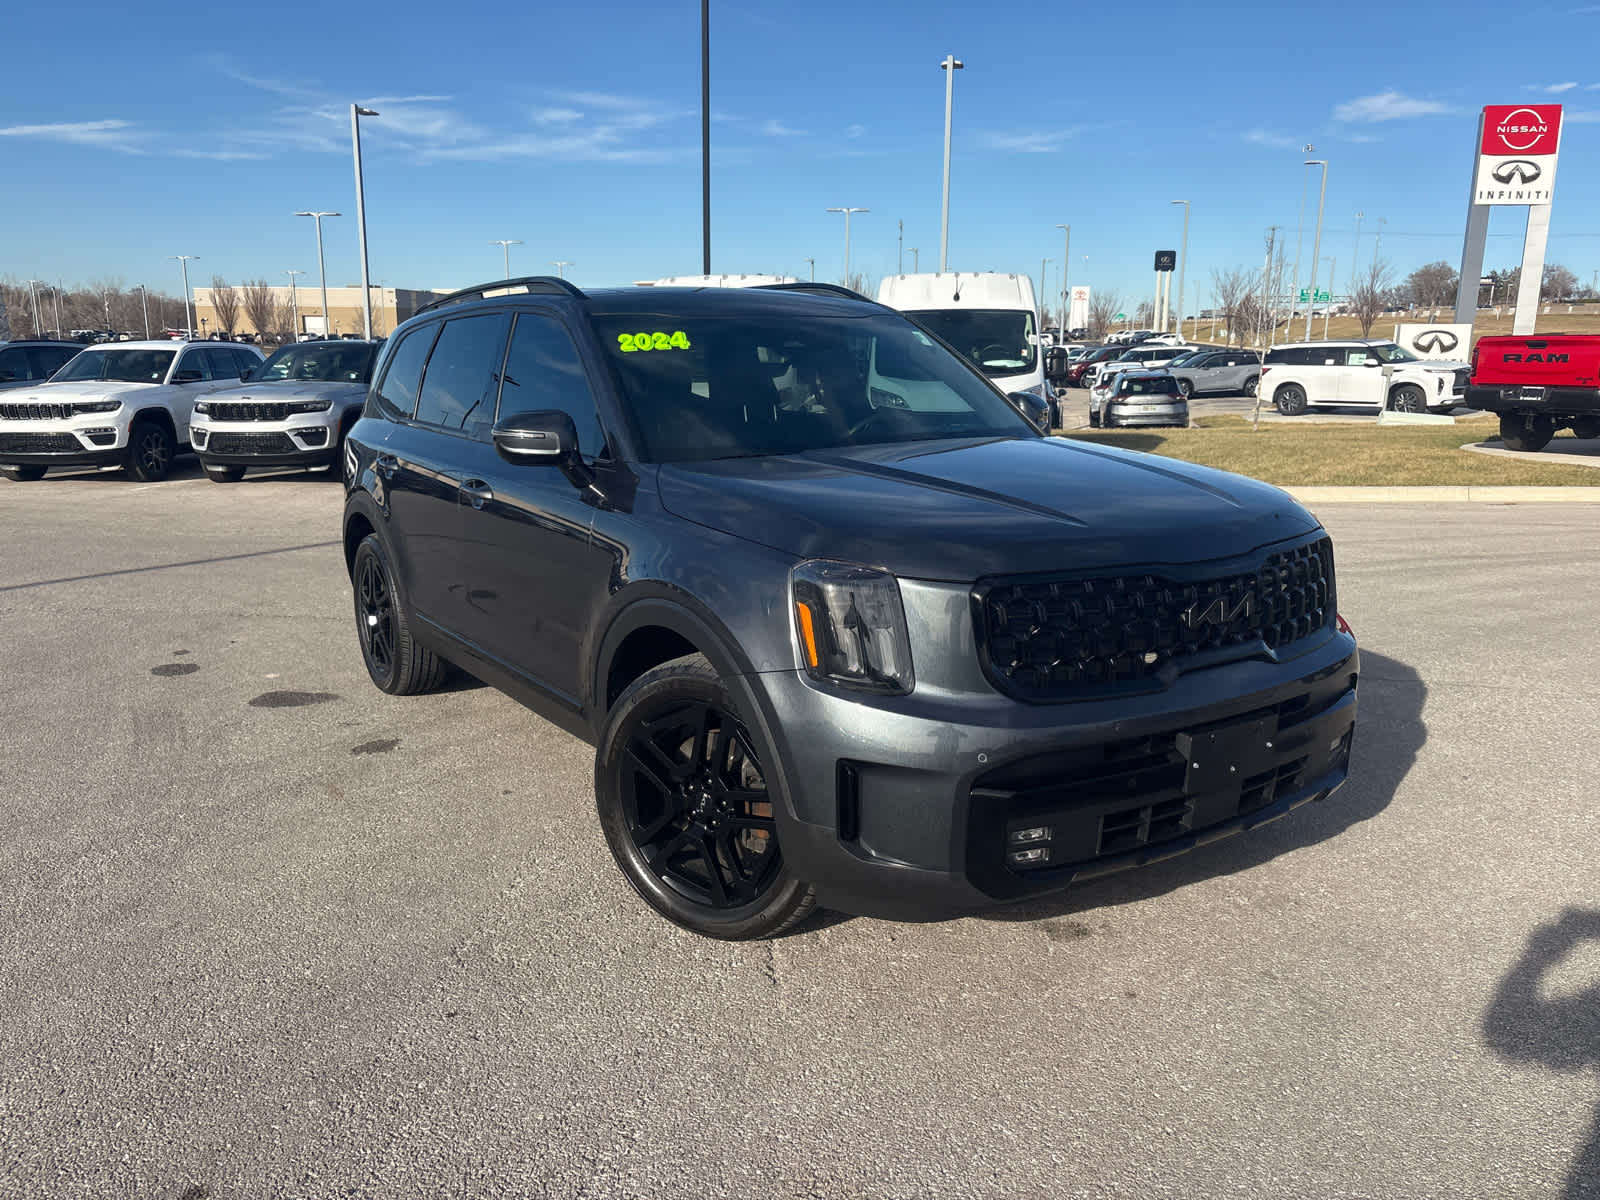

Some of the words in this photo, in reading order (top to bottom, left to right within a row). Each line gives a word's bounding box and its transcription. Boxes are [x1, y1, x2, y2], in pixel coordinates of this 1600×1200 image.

[1496, 125, 1548, 133] NISSAN
[1479, 190, 1549, 199] INFINITI
[617, 330, 691, 352] 2024
[1503, 353, 1570, 363] RAM
